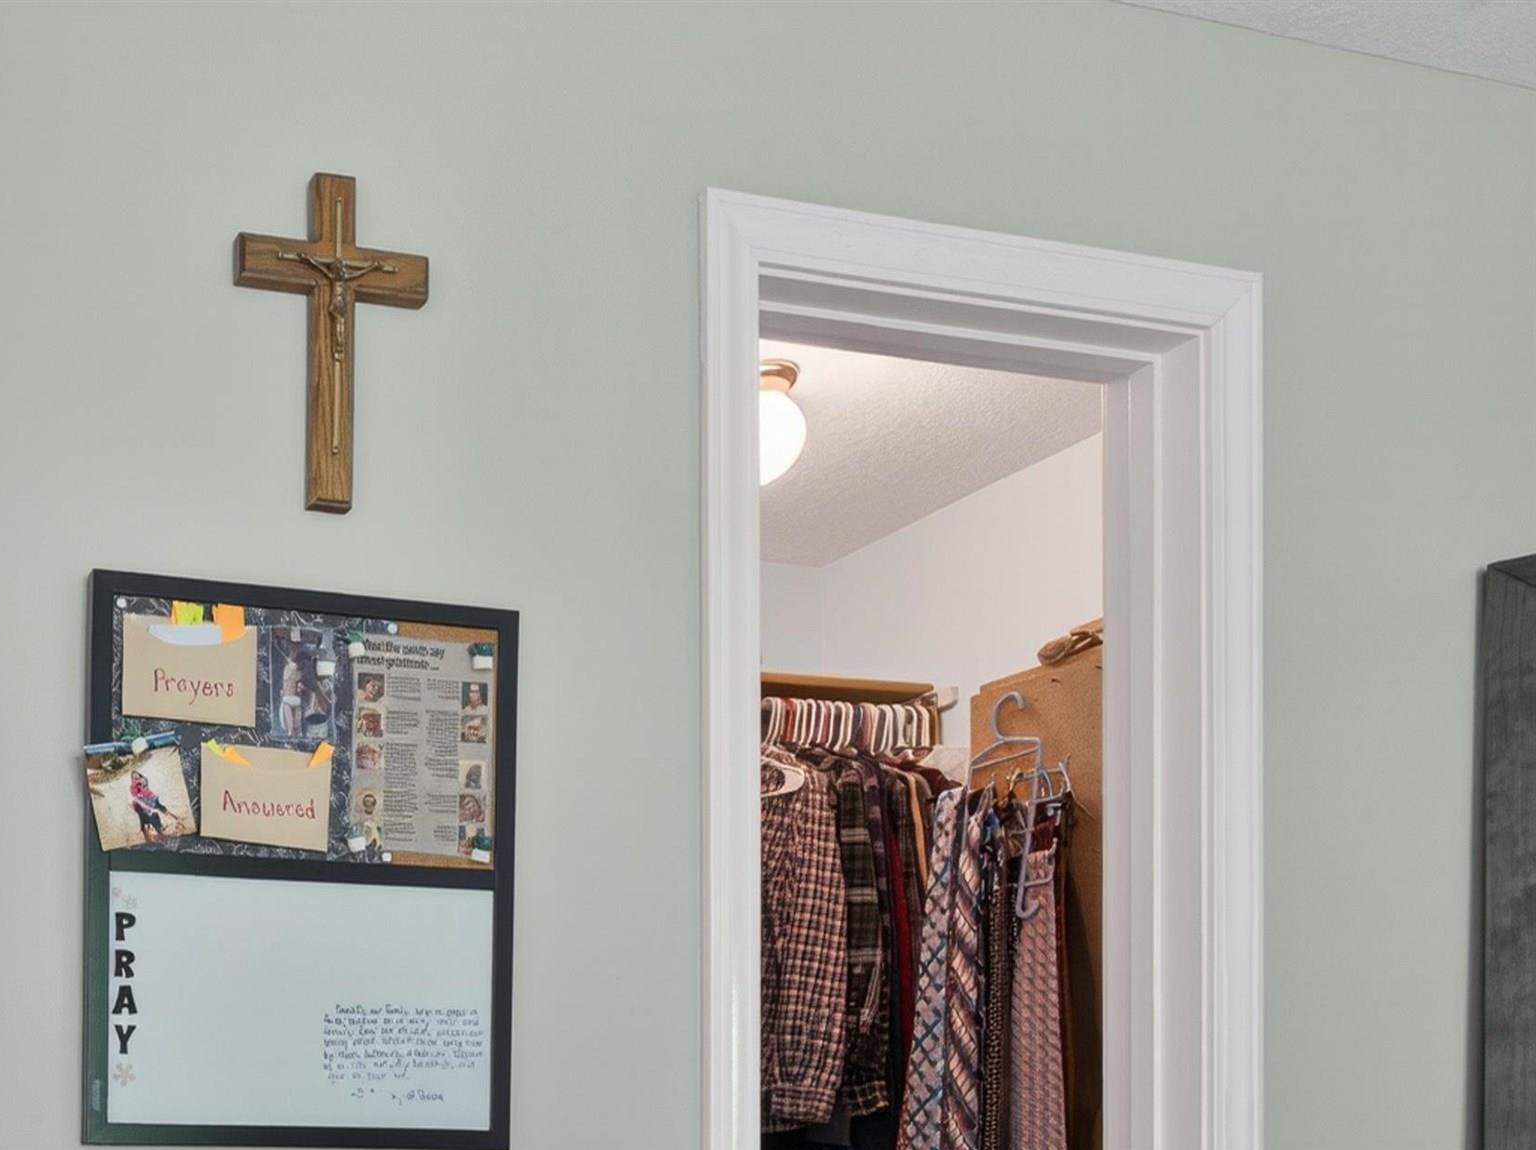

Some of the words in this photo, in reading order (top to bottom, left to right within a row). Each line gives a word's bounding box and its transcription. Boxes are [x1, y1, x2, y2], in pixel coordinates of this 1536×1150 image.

[153, 667, 234, 705] Prayers
[222, 789, 315, 819] Answered
[112, 911, 138, 1054] PRAY
